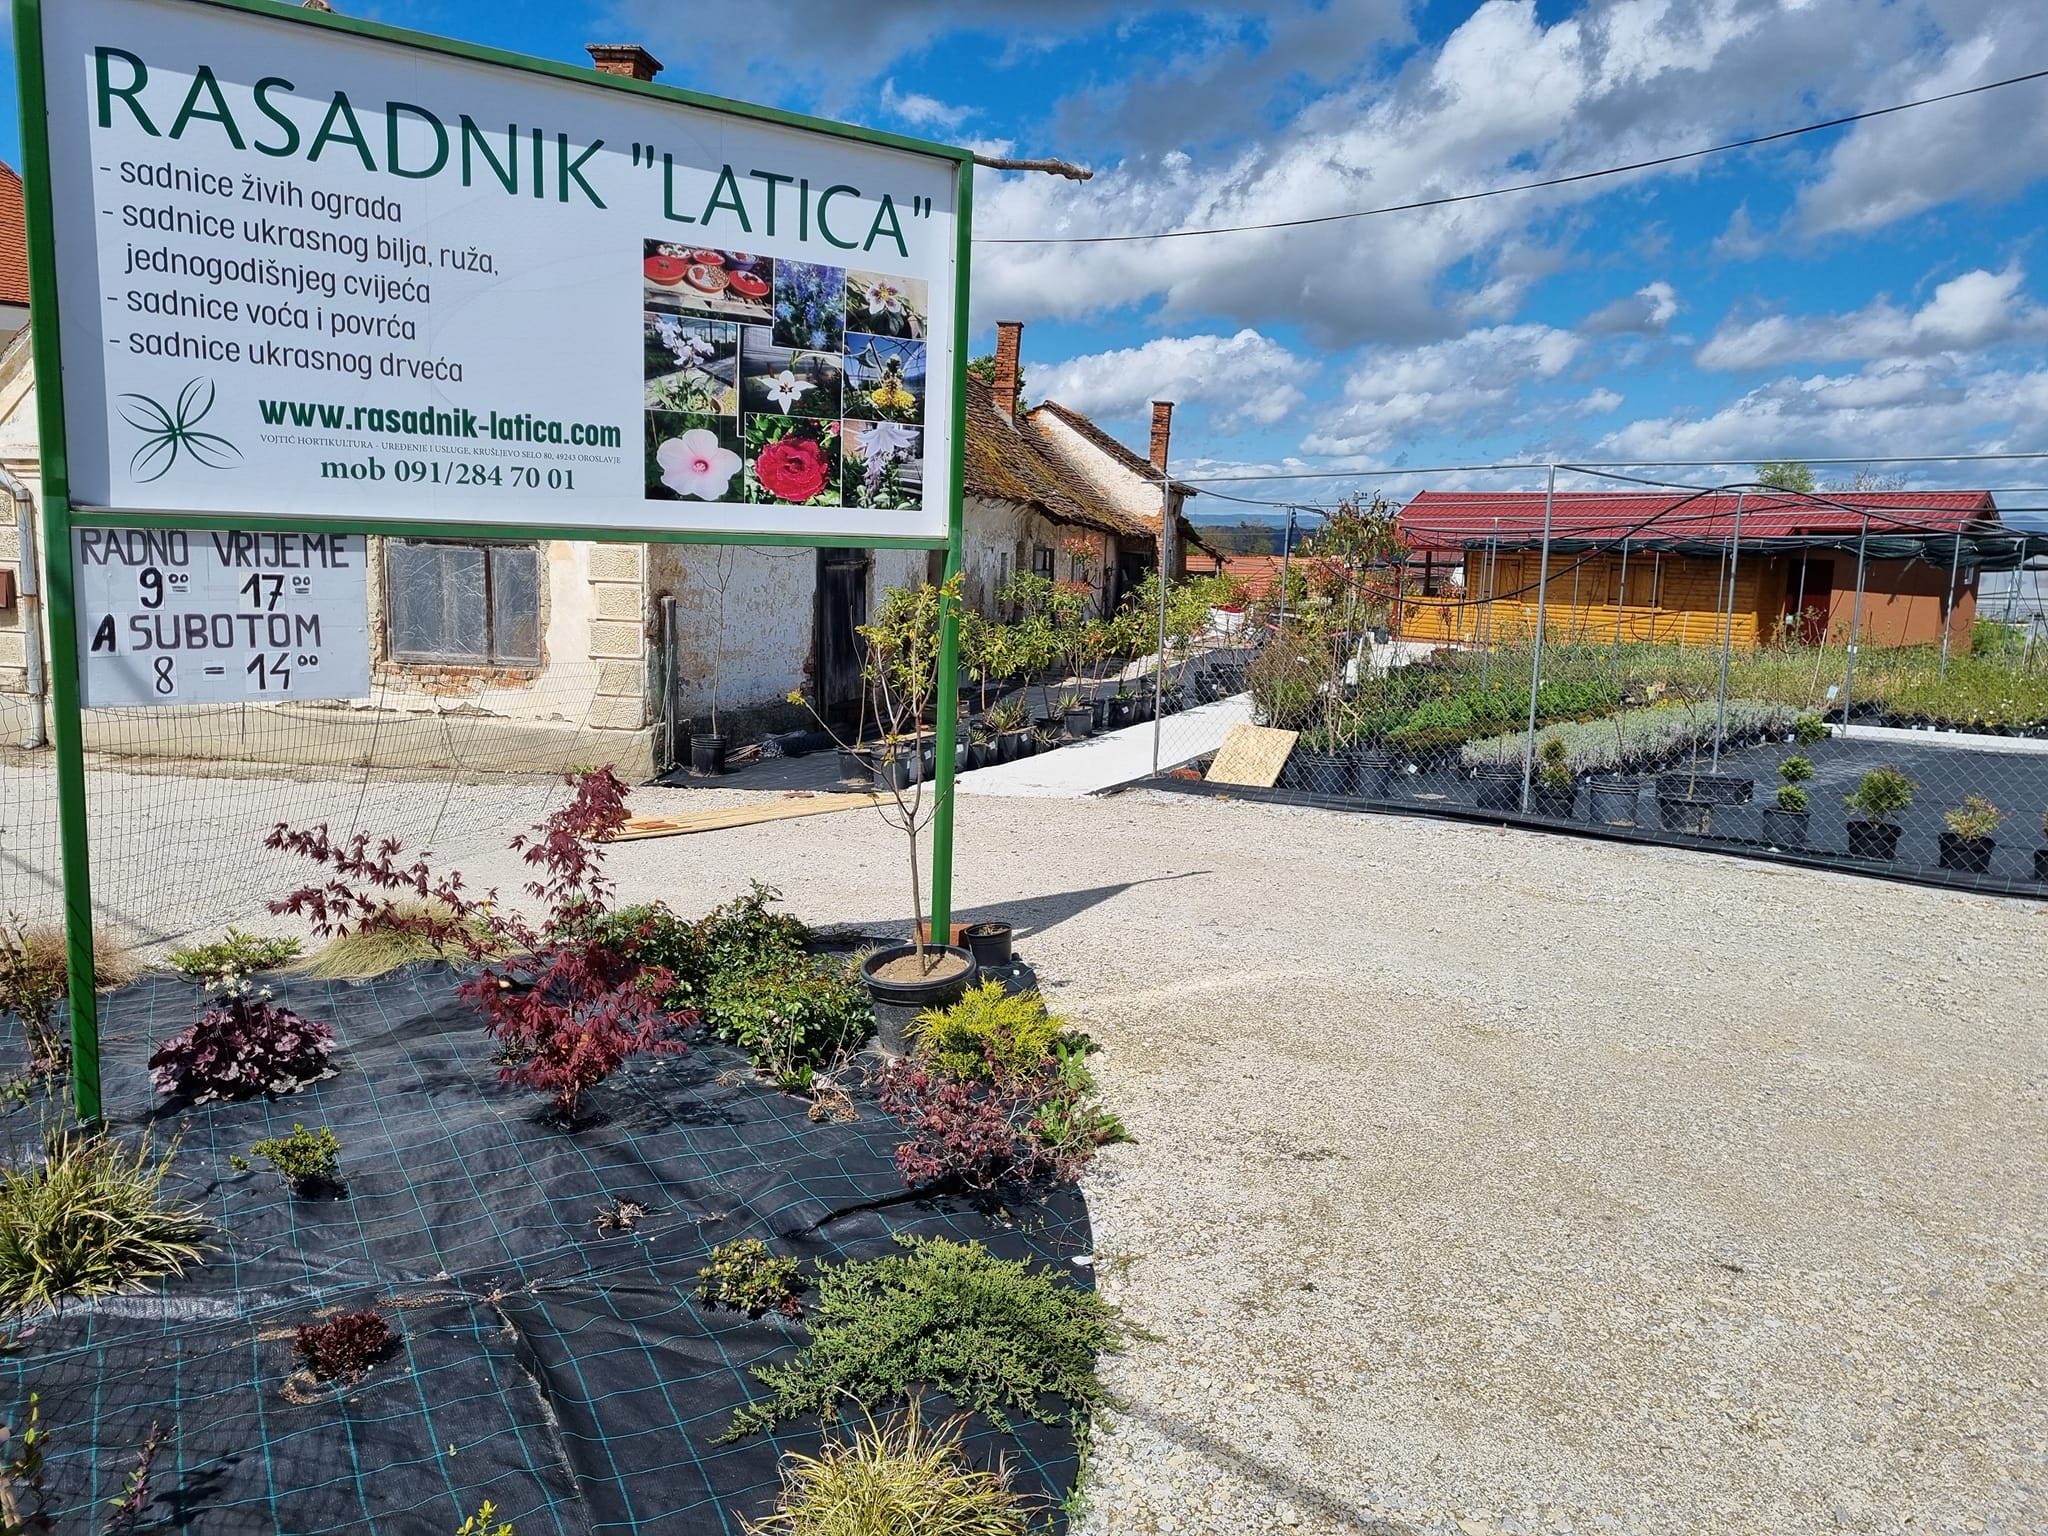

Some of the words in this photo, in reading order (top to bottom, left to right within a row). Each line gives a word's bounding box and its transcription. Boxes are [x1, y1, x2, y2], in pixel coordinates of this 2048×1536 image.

[94, 45, 608, 210] RASADNIK
[631, 142, 932, 258] "LATICA"
[120, 161, 233, 197] sadnice
[241, 173, 303, 208] živih
[311, 190, 401, 222] ograda
[122, 204, 235, 239] sadnice
[243, 218, 368, 262] ukrasnog
[377, 235, 433, 268] bilja,
[440, 246, 499, 276] ruža,
[124, 243, 336, 298] jednogodišnjeg
[344, 274, 430, 304] cvijeća
[127, 290, 238, 322] sadnice
[246, 305, 308, 329] voća
[317, 307, 322, 331] i
[331, 313, 416, 340] povrća
[129, 332, 240, 362] sadnice
[248, 341, 372, 379] ukrasnog
[380, 353, 463, 382] drveća
[258, 400, 621, 448] www.rasadnik-latica.com
[297, 437, 373, 449] HORTIKULTURA
[435, 445, 471, 454] USLUGE,
[543, 452, 554, 461] 80,
[577, 454, 621, 464] OROSLAVJE
[321, 457, 385, 481] mob
[394, 460, 502, 487] 091/284
[509, 466, 540, 488] 70
[547, 467, 575, 489] 01
[80, 528, 189, 566] RADNO
[211, 531, 349, 568] VRIJEME
[90, 614, 116, 652] A
[130, 614, 321, 651] SUBOTOM
[153, 656, 174, 694] 8
